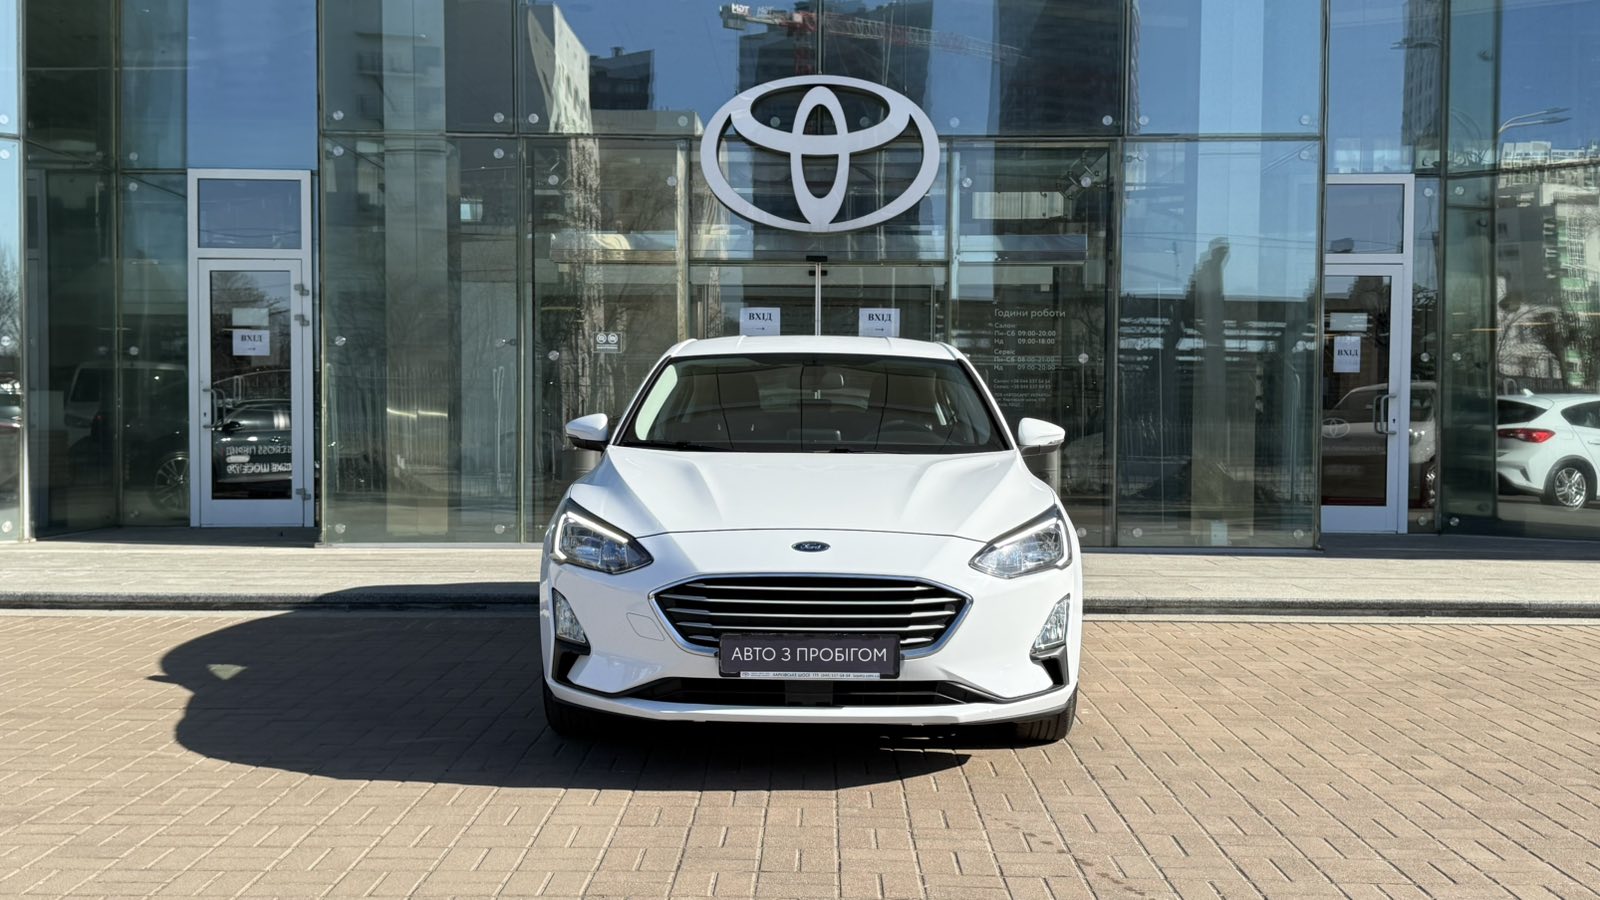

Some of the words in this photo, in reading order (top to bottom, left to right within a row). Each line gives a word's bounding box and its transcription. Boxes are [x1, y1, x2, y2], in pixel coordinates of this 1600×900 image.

[748, 312, 773, 322] ВХІД
[868, 313, 892, 322] ВХІД
[994, 309, 1028, 318] Години
[1030, 308, 1066, 319] роботи
[240, 334, 263, 342] ВХІД
[1337, 349, 1359, 357] ВХІД
[731, 647, 776, 661] АВТО
[796, 647, 887, 662] ПРОБІГОМ
